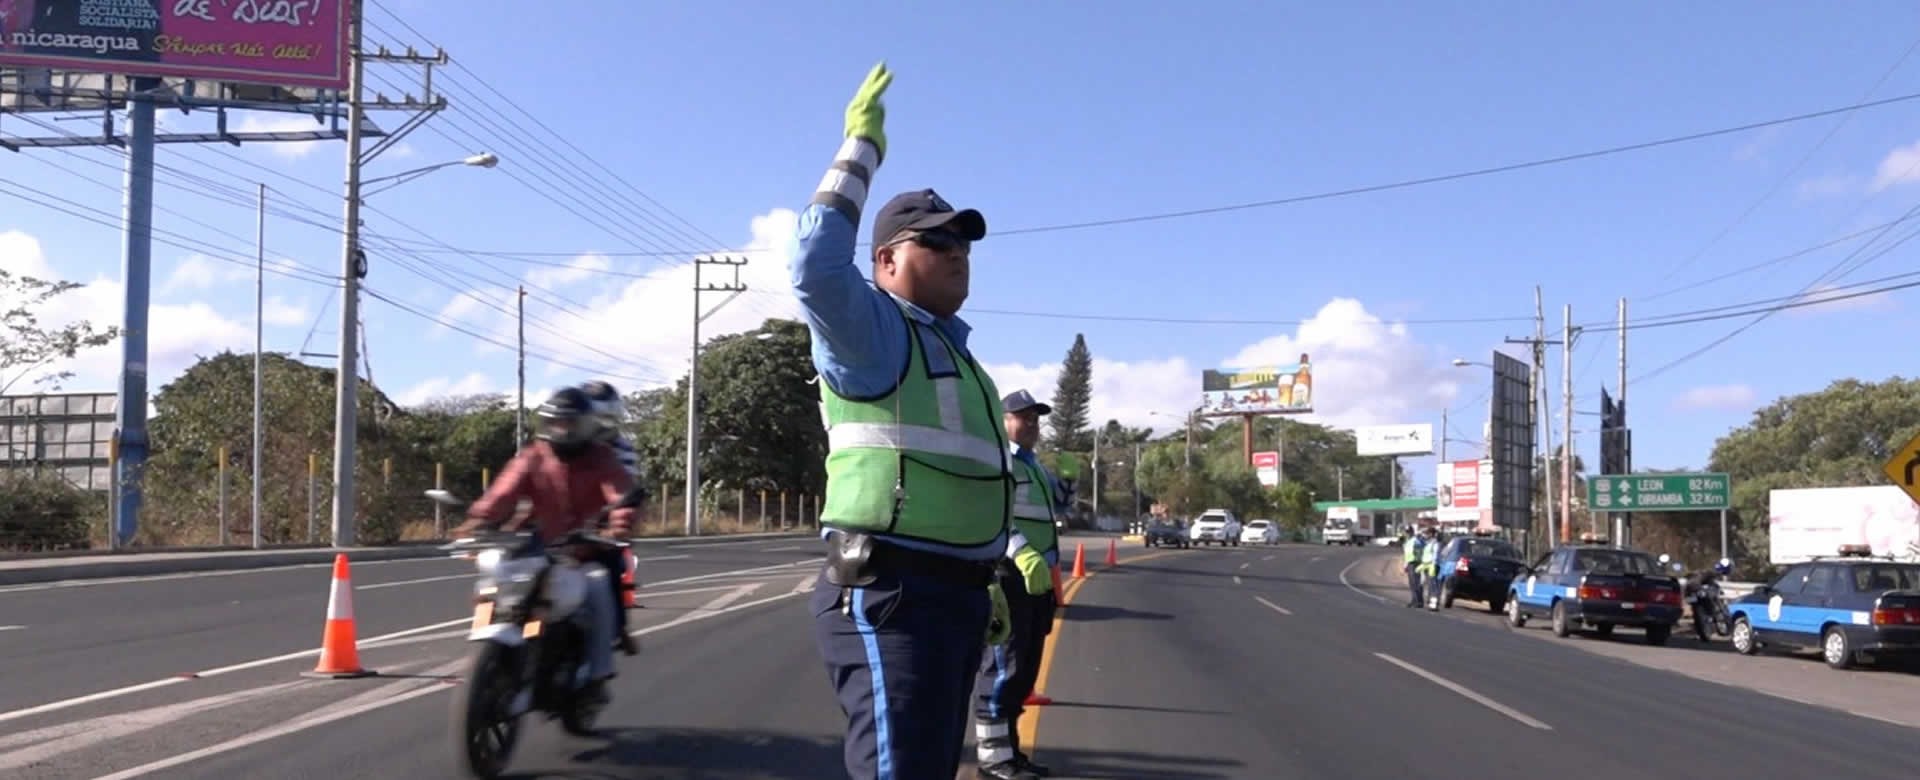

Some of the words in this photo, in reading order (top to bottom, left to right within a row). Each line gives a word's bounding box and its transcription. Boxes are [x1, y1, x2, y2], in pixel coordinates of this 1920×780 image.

[80, 5, 159, 19] SOCIALISTA
[79, 15, 157, 29] SOLIDARIA!
[12, 28, 139, 54] nicaragua
[1637, 479, 1664, 491] LEON
[1638, 492, 1684, 505] DIRIAMBA
